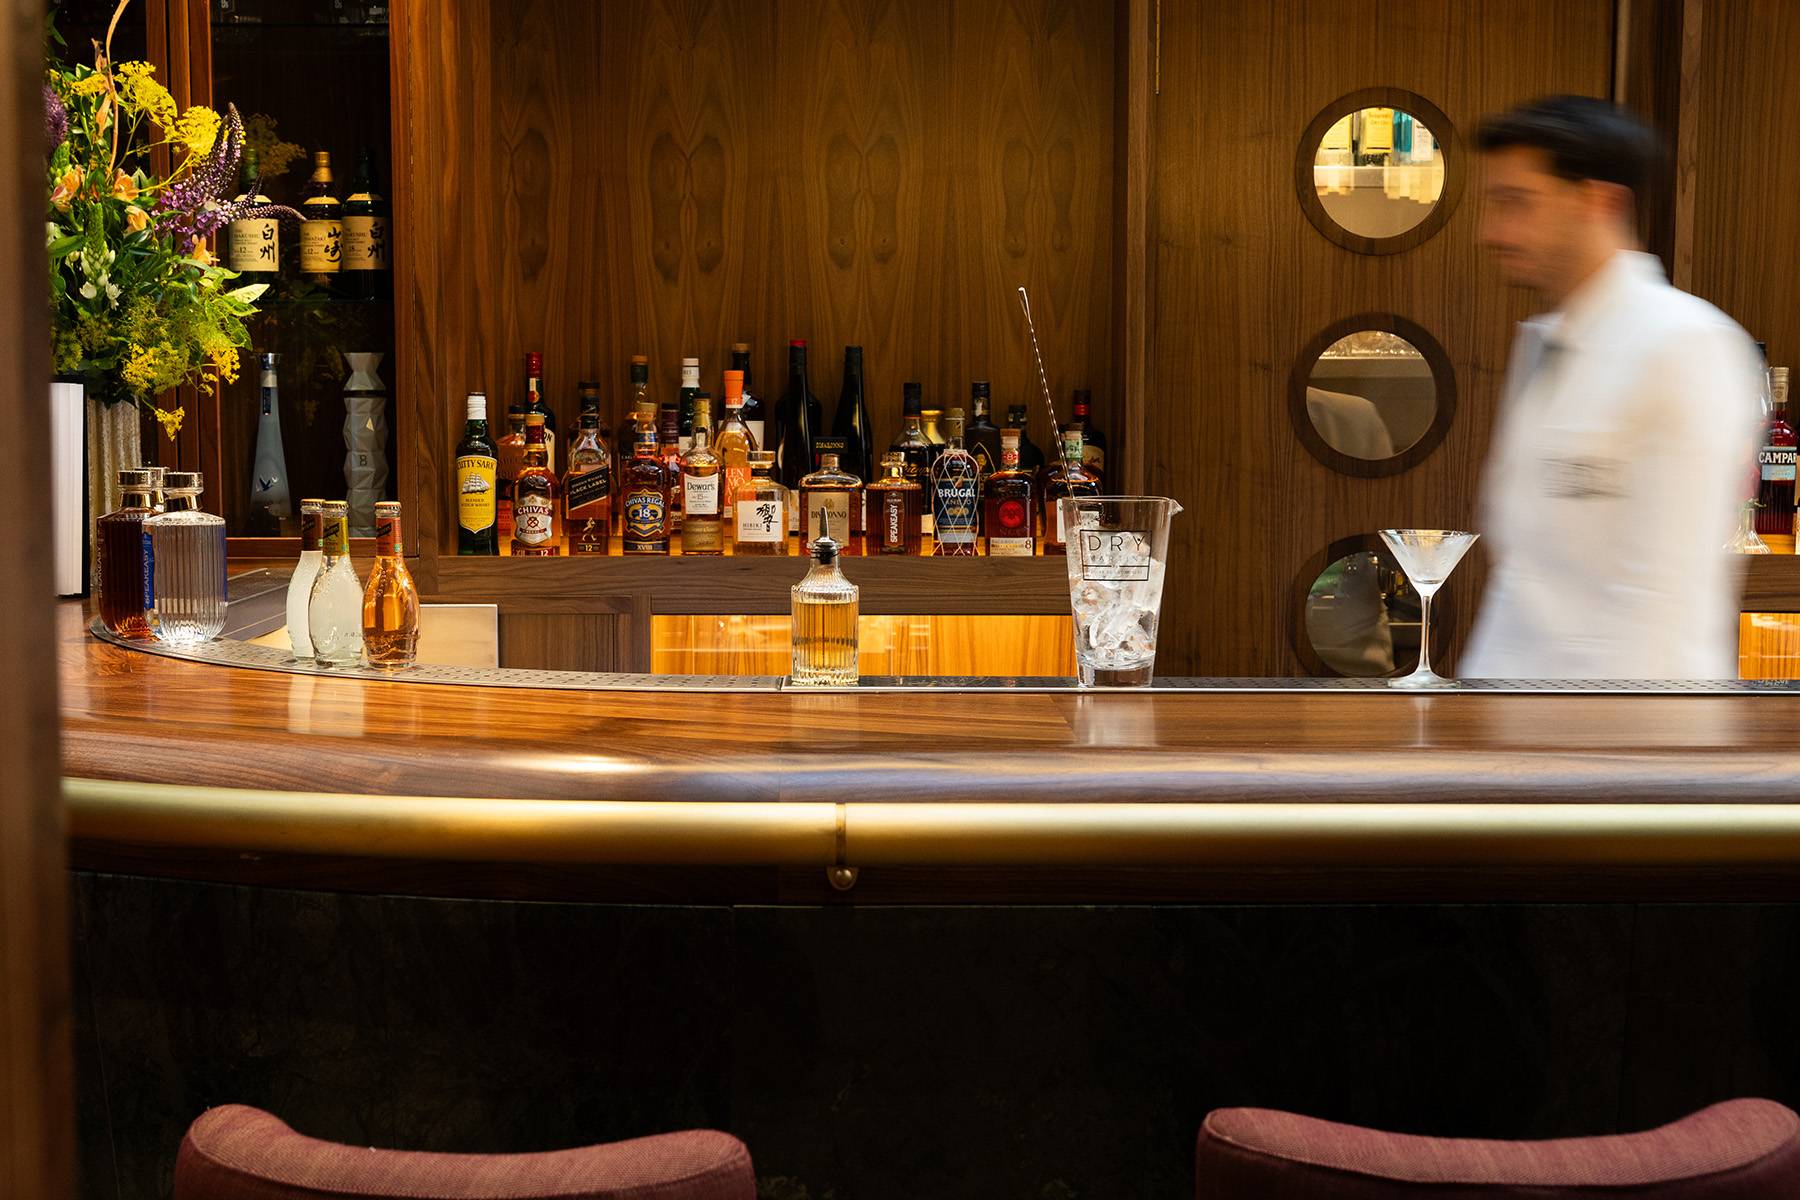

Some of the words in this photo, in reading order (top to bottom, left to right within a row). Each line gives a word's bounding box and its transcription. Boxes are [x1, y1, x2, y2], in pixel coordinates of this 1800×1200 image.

[260, 223, 275, 263] 白州
[1759, 452, 1797, 464] CAMPAR
[588, 480, 607, 489] LABEL
[938, 488, 976, 497] BRUGAL
[625, 497, 646, 507] CHIVAS
[647, 496, 665, 507] REGAL
[517, 506, 549, 514] CHIVAS
[639, 508, 651, 518] 18
[811, 511, 847, 519] DISONNO
[889, 504, 898, 543] SPEAKEASY
[585, 544, 593, 552] 12
[1024, 540, 1032, 549] 8
[1088, 535, 1146, 552] DRY
[540, 548, 549, 556] 12
